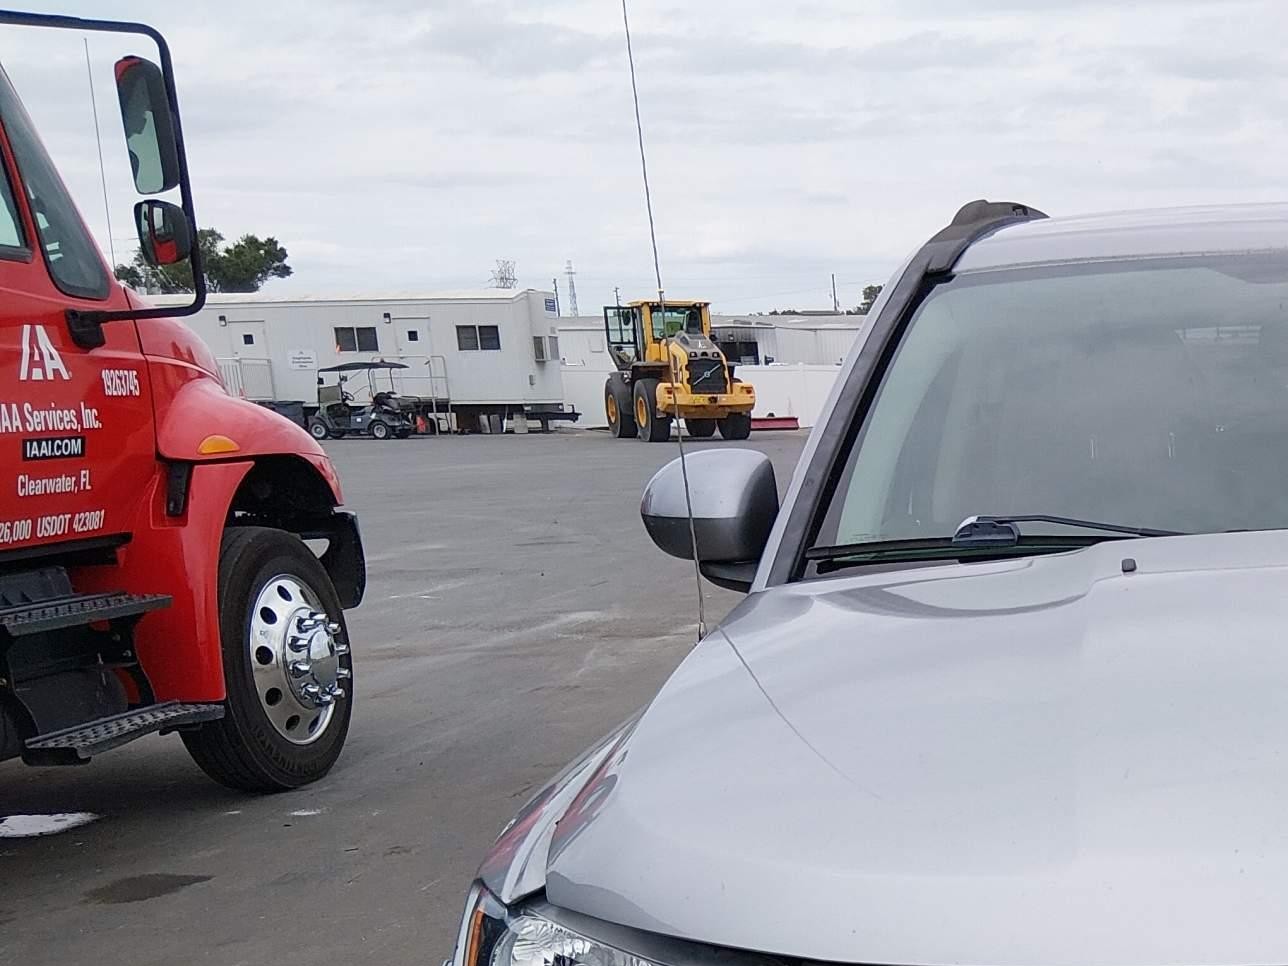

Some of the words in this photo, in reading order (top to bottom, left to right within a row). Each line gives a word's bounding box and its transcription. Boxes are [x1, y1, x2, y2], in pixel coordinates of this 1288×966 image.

[101, 368, 140, 397] 19263745
[0, 403, 23, 433] AA
[24, 403, 81, 433] Services,
[81, 401, 102, 430] Inc.
[26, 438, 82, 458] IAAI.COM
[18, 473, 78, 497] Clearwater,
[79, 470, 91, 491] FL
[37, 514, 71, 538] USDOT
[72, 509, 105, 533] 423081
